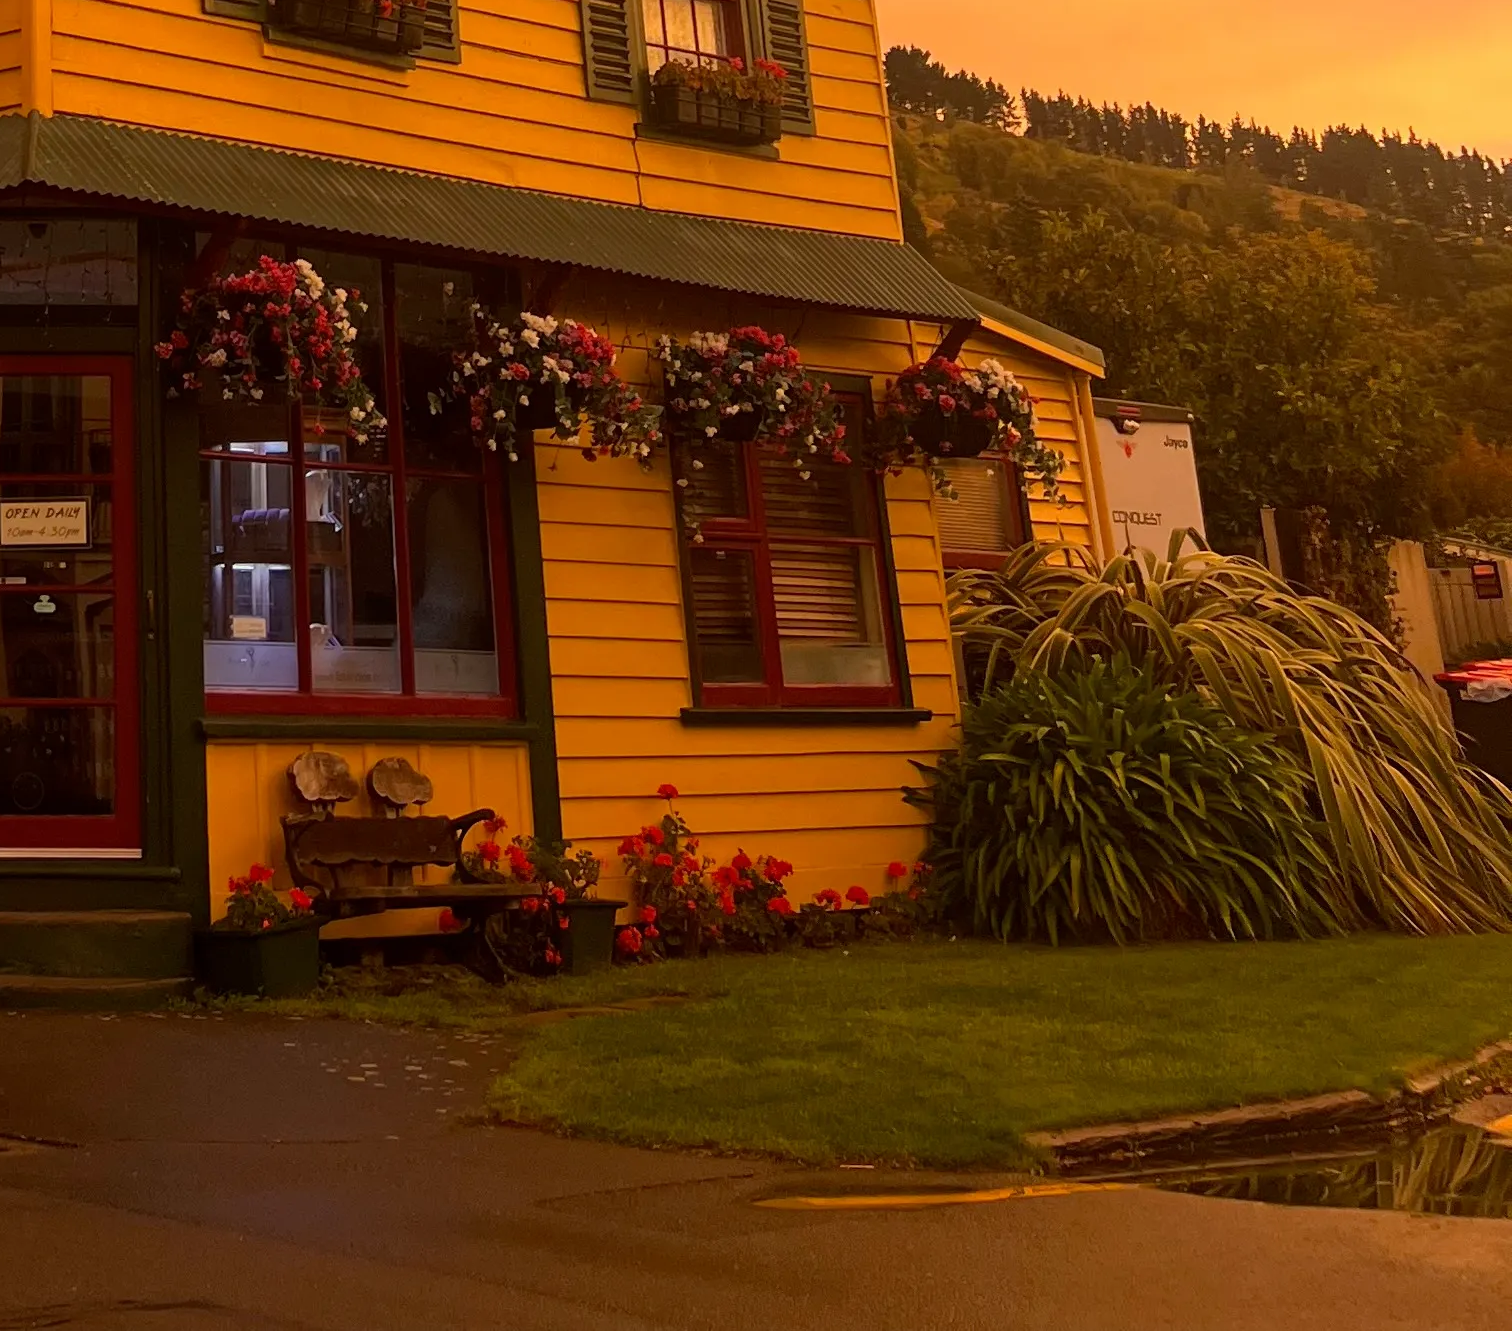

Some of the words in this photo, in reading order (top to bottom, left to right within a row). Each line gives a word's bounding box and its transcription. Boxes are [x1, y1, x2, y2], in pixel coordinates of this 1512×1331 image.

[1163, 435, 1188, 450] Jayco
[5, 507, 41, 519] OPEN
[45, 506, 81, 520] DAILY
[1111, 510, 1162, 526] CONQUEST
